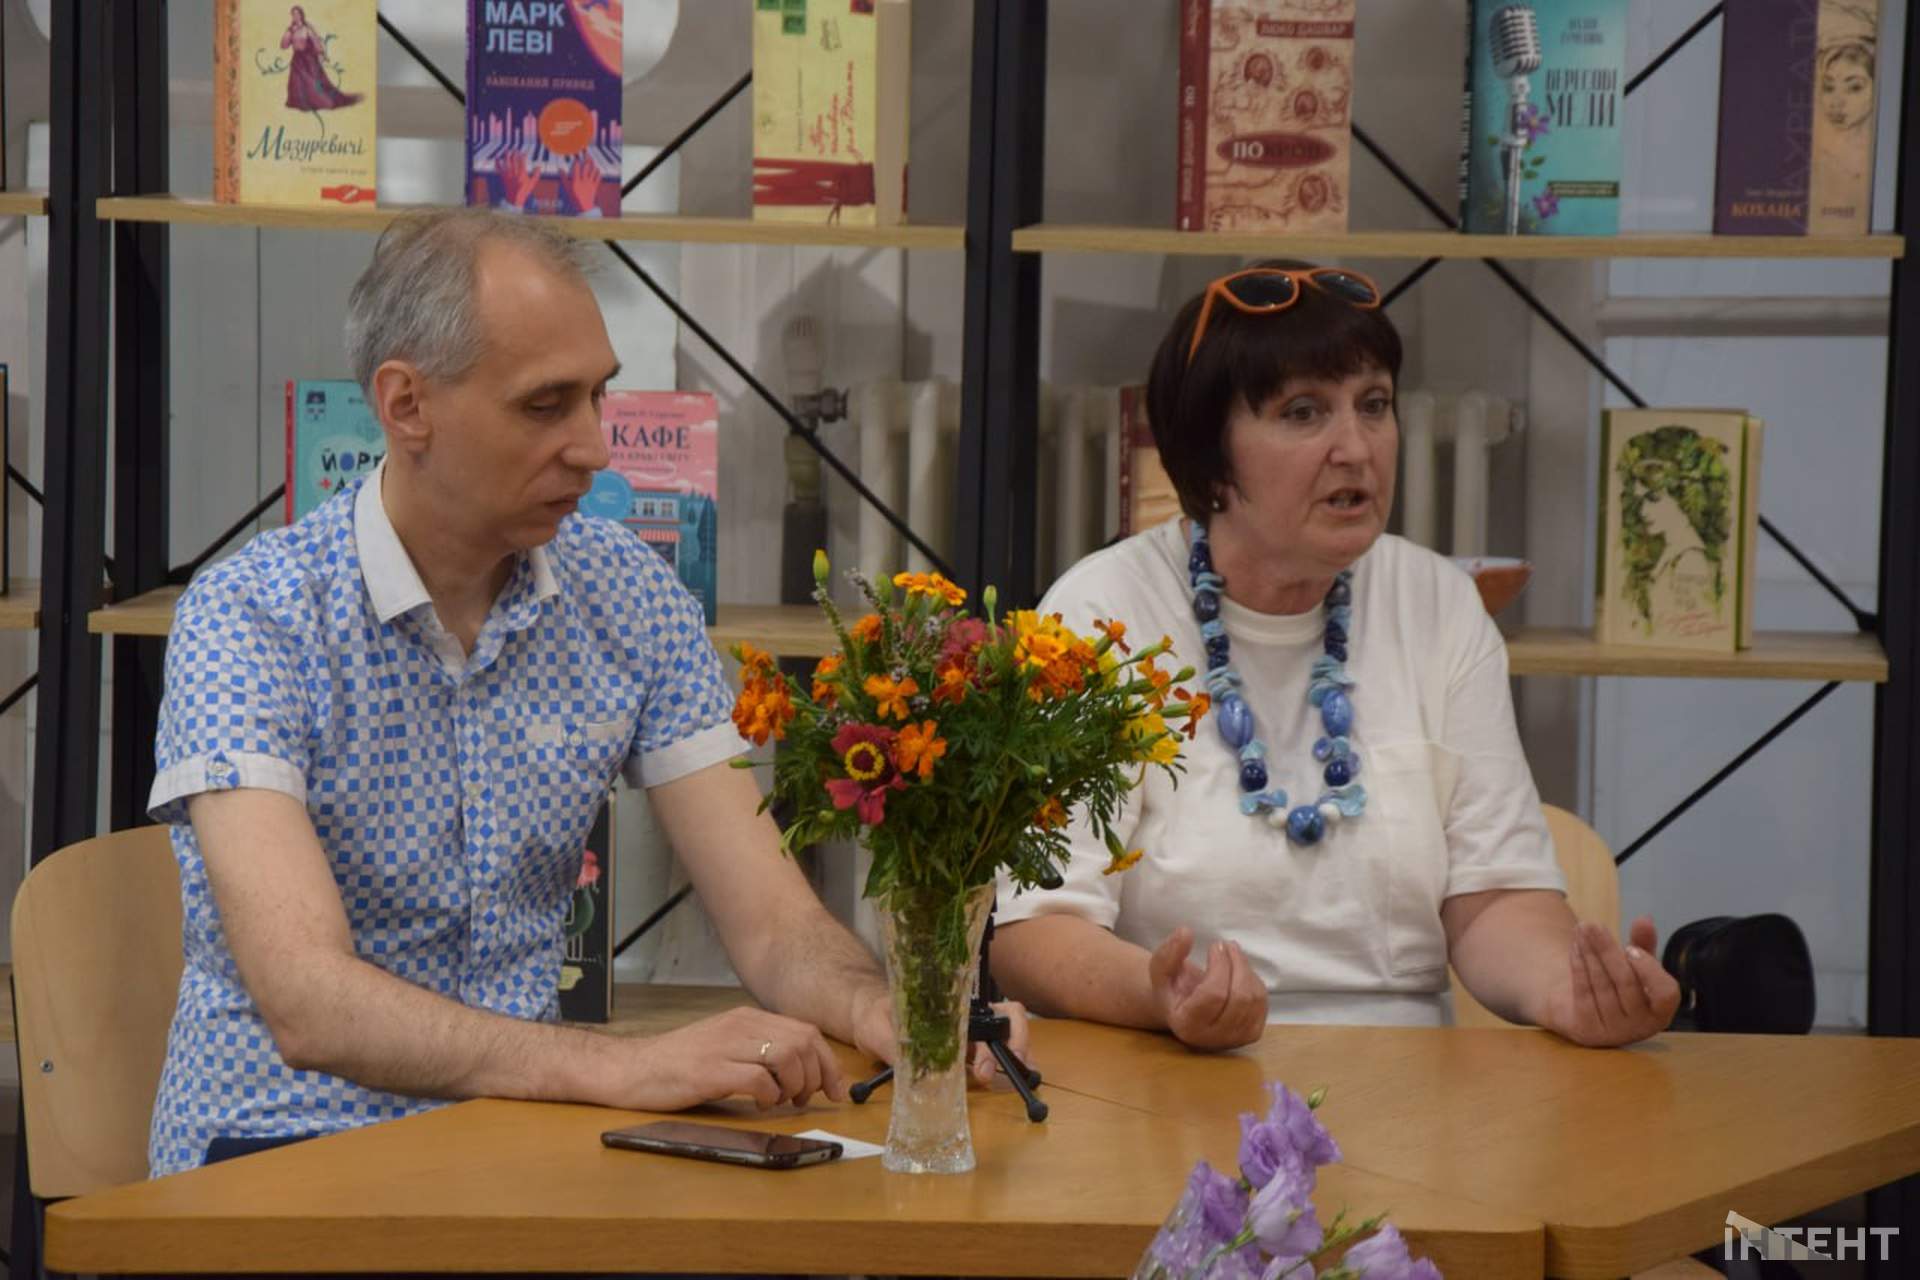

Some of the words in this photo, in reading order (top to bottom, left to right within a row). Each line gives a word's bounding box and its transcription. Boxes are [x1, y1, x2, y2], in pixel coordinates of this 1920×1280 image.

[485, 1, 565, 27] МАРК
[485, 28, 553, 54] ЛЕВІ
[246, 125, 364, 162] Мазуревичі
[611, 423, 691, 449] КАФЕ
